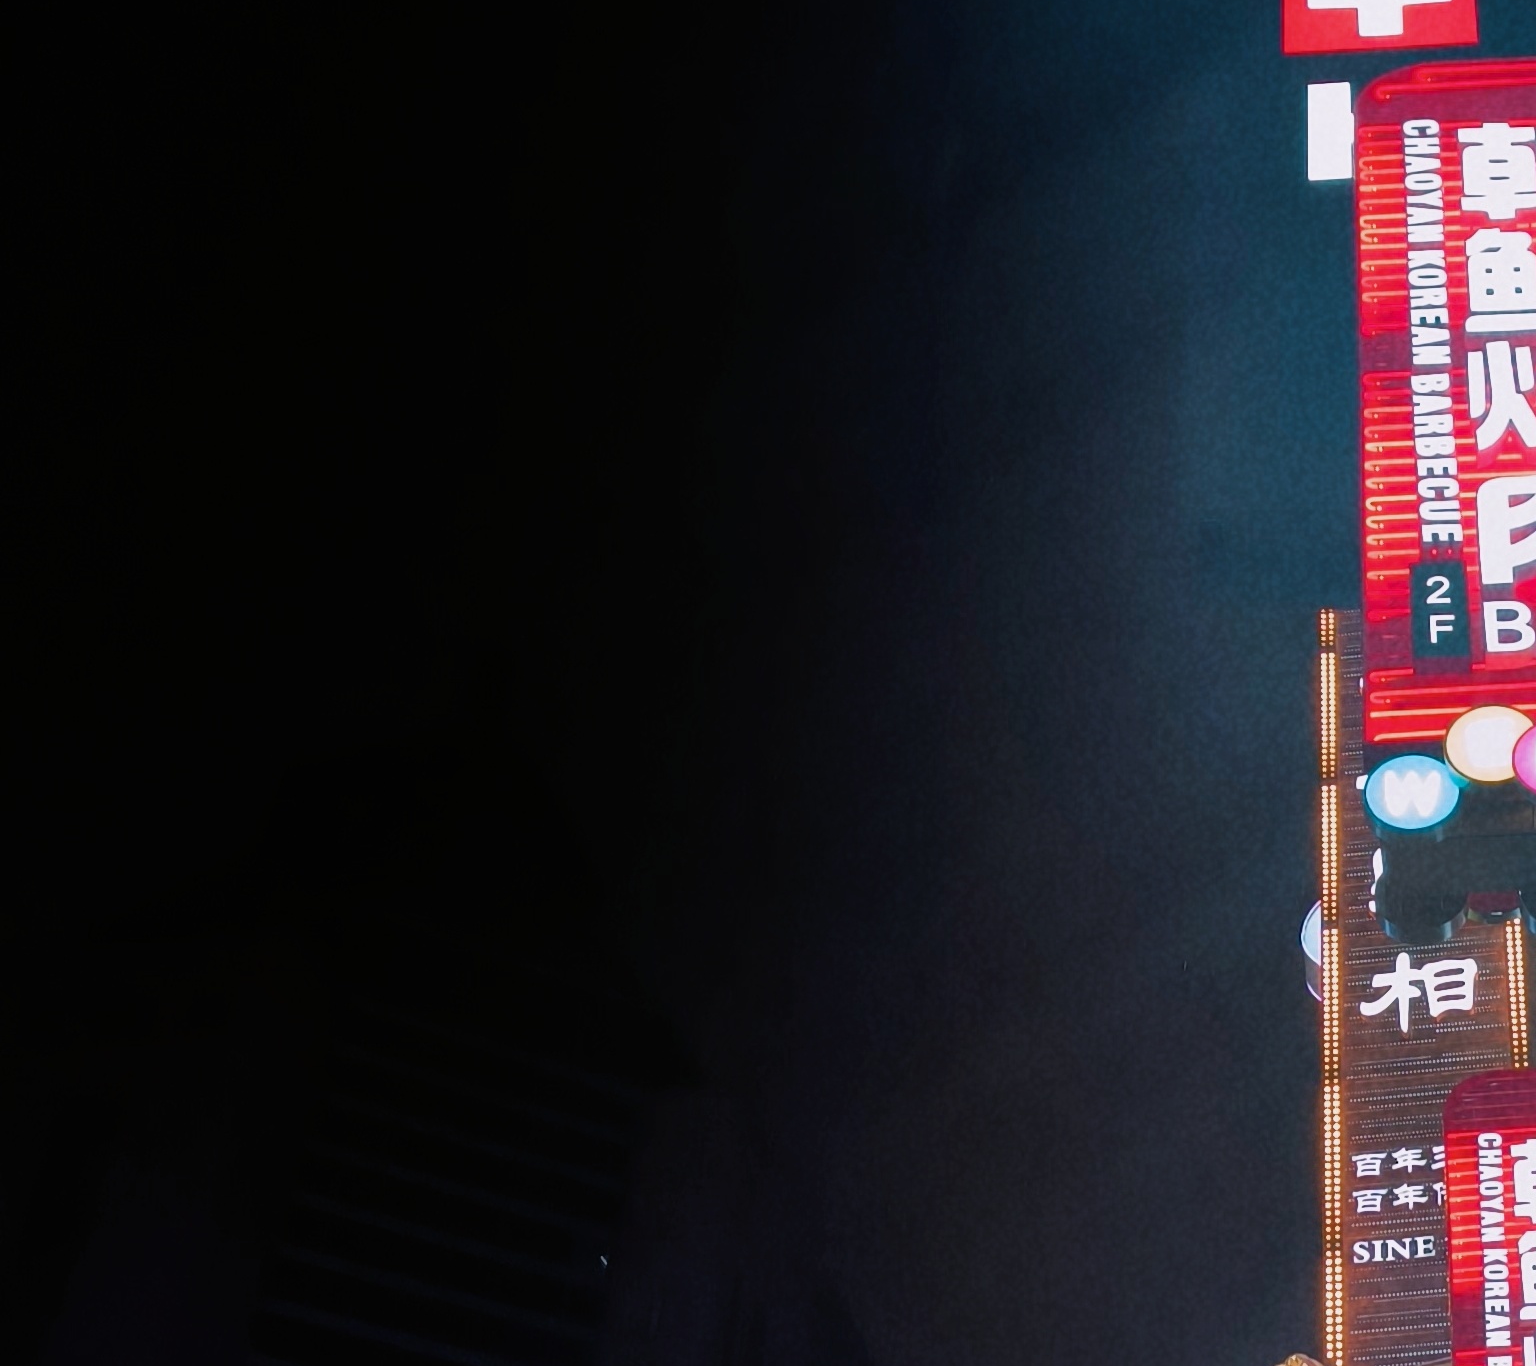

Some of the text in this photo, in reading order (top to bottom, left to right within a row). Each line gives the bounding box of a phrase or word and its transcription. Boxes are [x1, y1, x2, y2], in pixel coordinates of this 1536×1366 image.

[1402, 119, 1463, 546] CHAOYAN KOREAN BARBECUE
[1425, 576, 1454, 645] 2F
[1477, 1132, 1504, 1233] CHAOYAN
[1482, 1238, 1512, 1349] KOREAN
